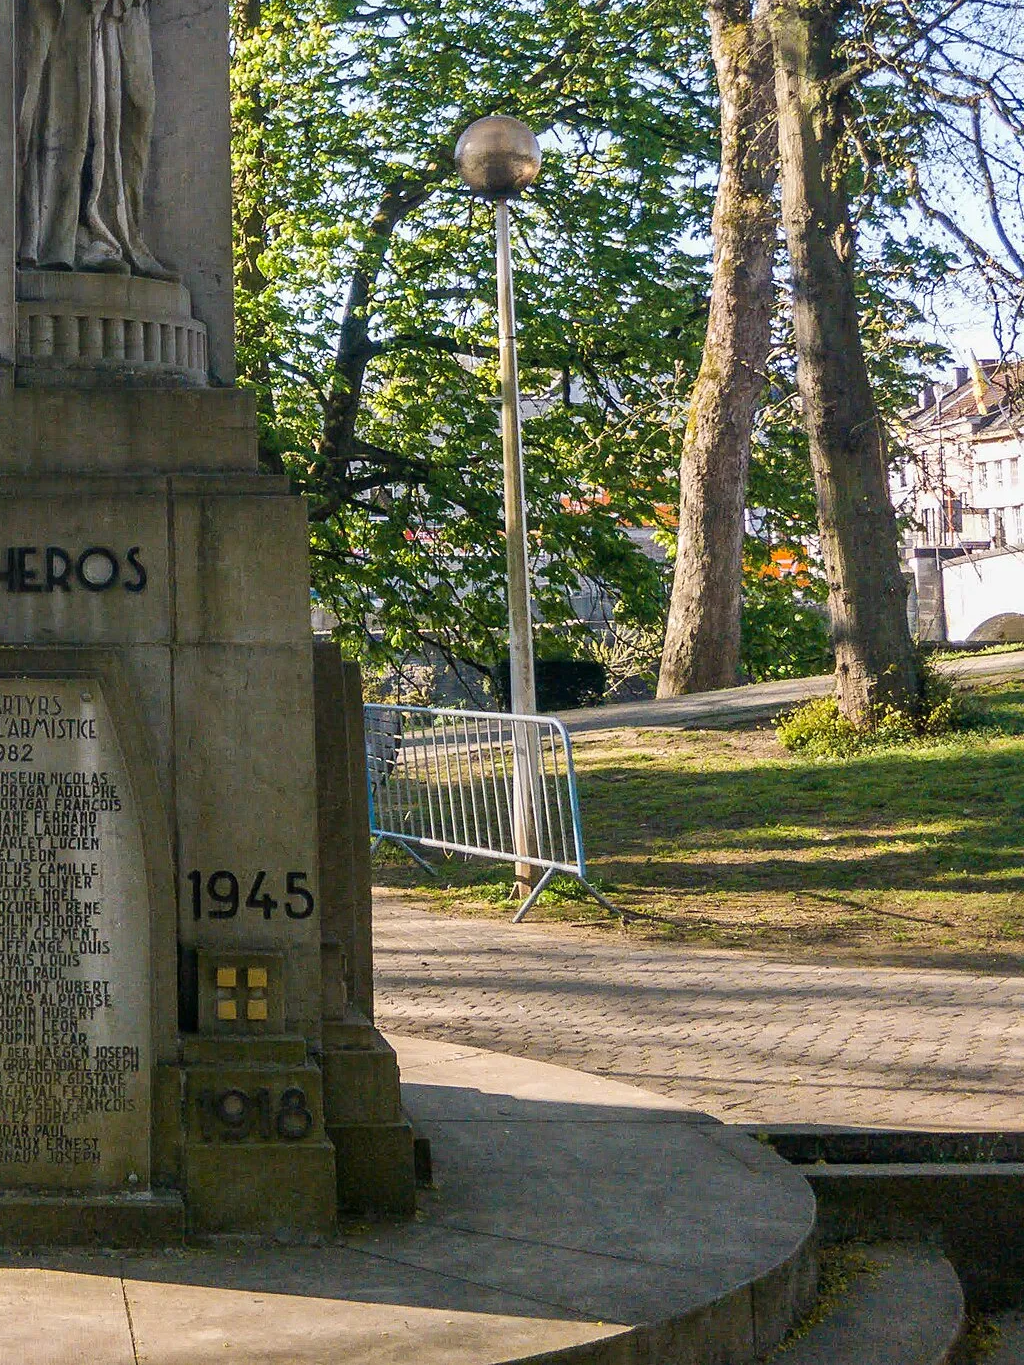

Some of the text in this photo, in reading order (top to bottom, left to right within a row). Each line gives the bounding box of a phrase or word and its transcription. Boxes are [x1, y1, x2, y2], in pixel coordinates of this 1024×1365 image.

[51, 771, 108, 784] NICOLAS
[57, 785, 117, 798] ADOLPHE
[35, 811, 97, 824] FERNAND
[35, 824, 97, 836] LAURENT
[51, 837, 99, 849] LUCIEN
[21, 849, 56, 861] LEON
[39, 862, 98, 875] CAMILLE
[39, 876, 92, 888] OLIVIER
[187, 869, 314, 921] 1945
[66, 902, 101, 914] RENE
[39, 915, 92, 927] ISIDORE
[34, 928, 98, 940] CLEMENT
[70, 941, 110, 954] LOUIS
[40, 954, 80, 966] LOUIS
[34, 967, 65, 979] PAUL
[56, 980, 109, 993] HUBERT
[40, 993, 112, 1006] ALPHONSE
[42, 1006, 95, 1019] HUBERT
[42, 1020, 78, 1032] LEON
[42, 1033, 87, 1045] OSCAR
[8, 1046, 28, 1058] DER
[36, 1046, 89, 1058] HAEGEN
[95, 1046, 139, 1058] JOSEPH
[95, 1059, 139, 1071] JOSEPH
[7, 1071, 61, 1084] SCHOOR
[68, 1072, 125, 1084] GUSTAVE
[194, 1087, 313, 1139] 1918
[35, 1124, 66, 1137] PAUL
[47, 1138, 99, 1151] ERNEST
[47, 1151, 100, 1163] JOSEPH
